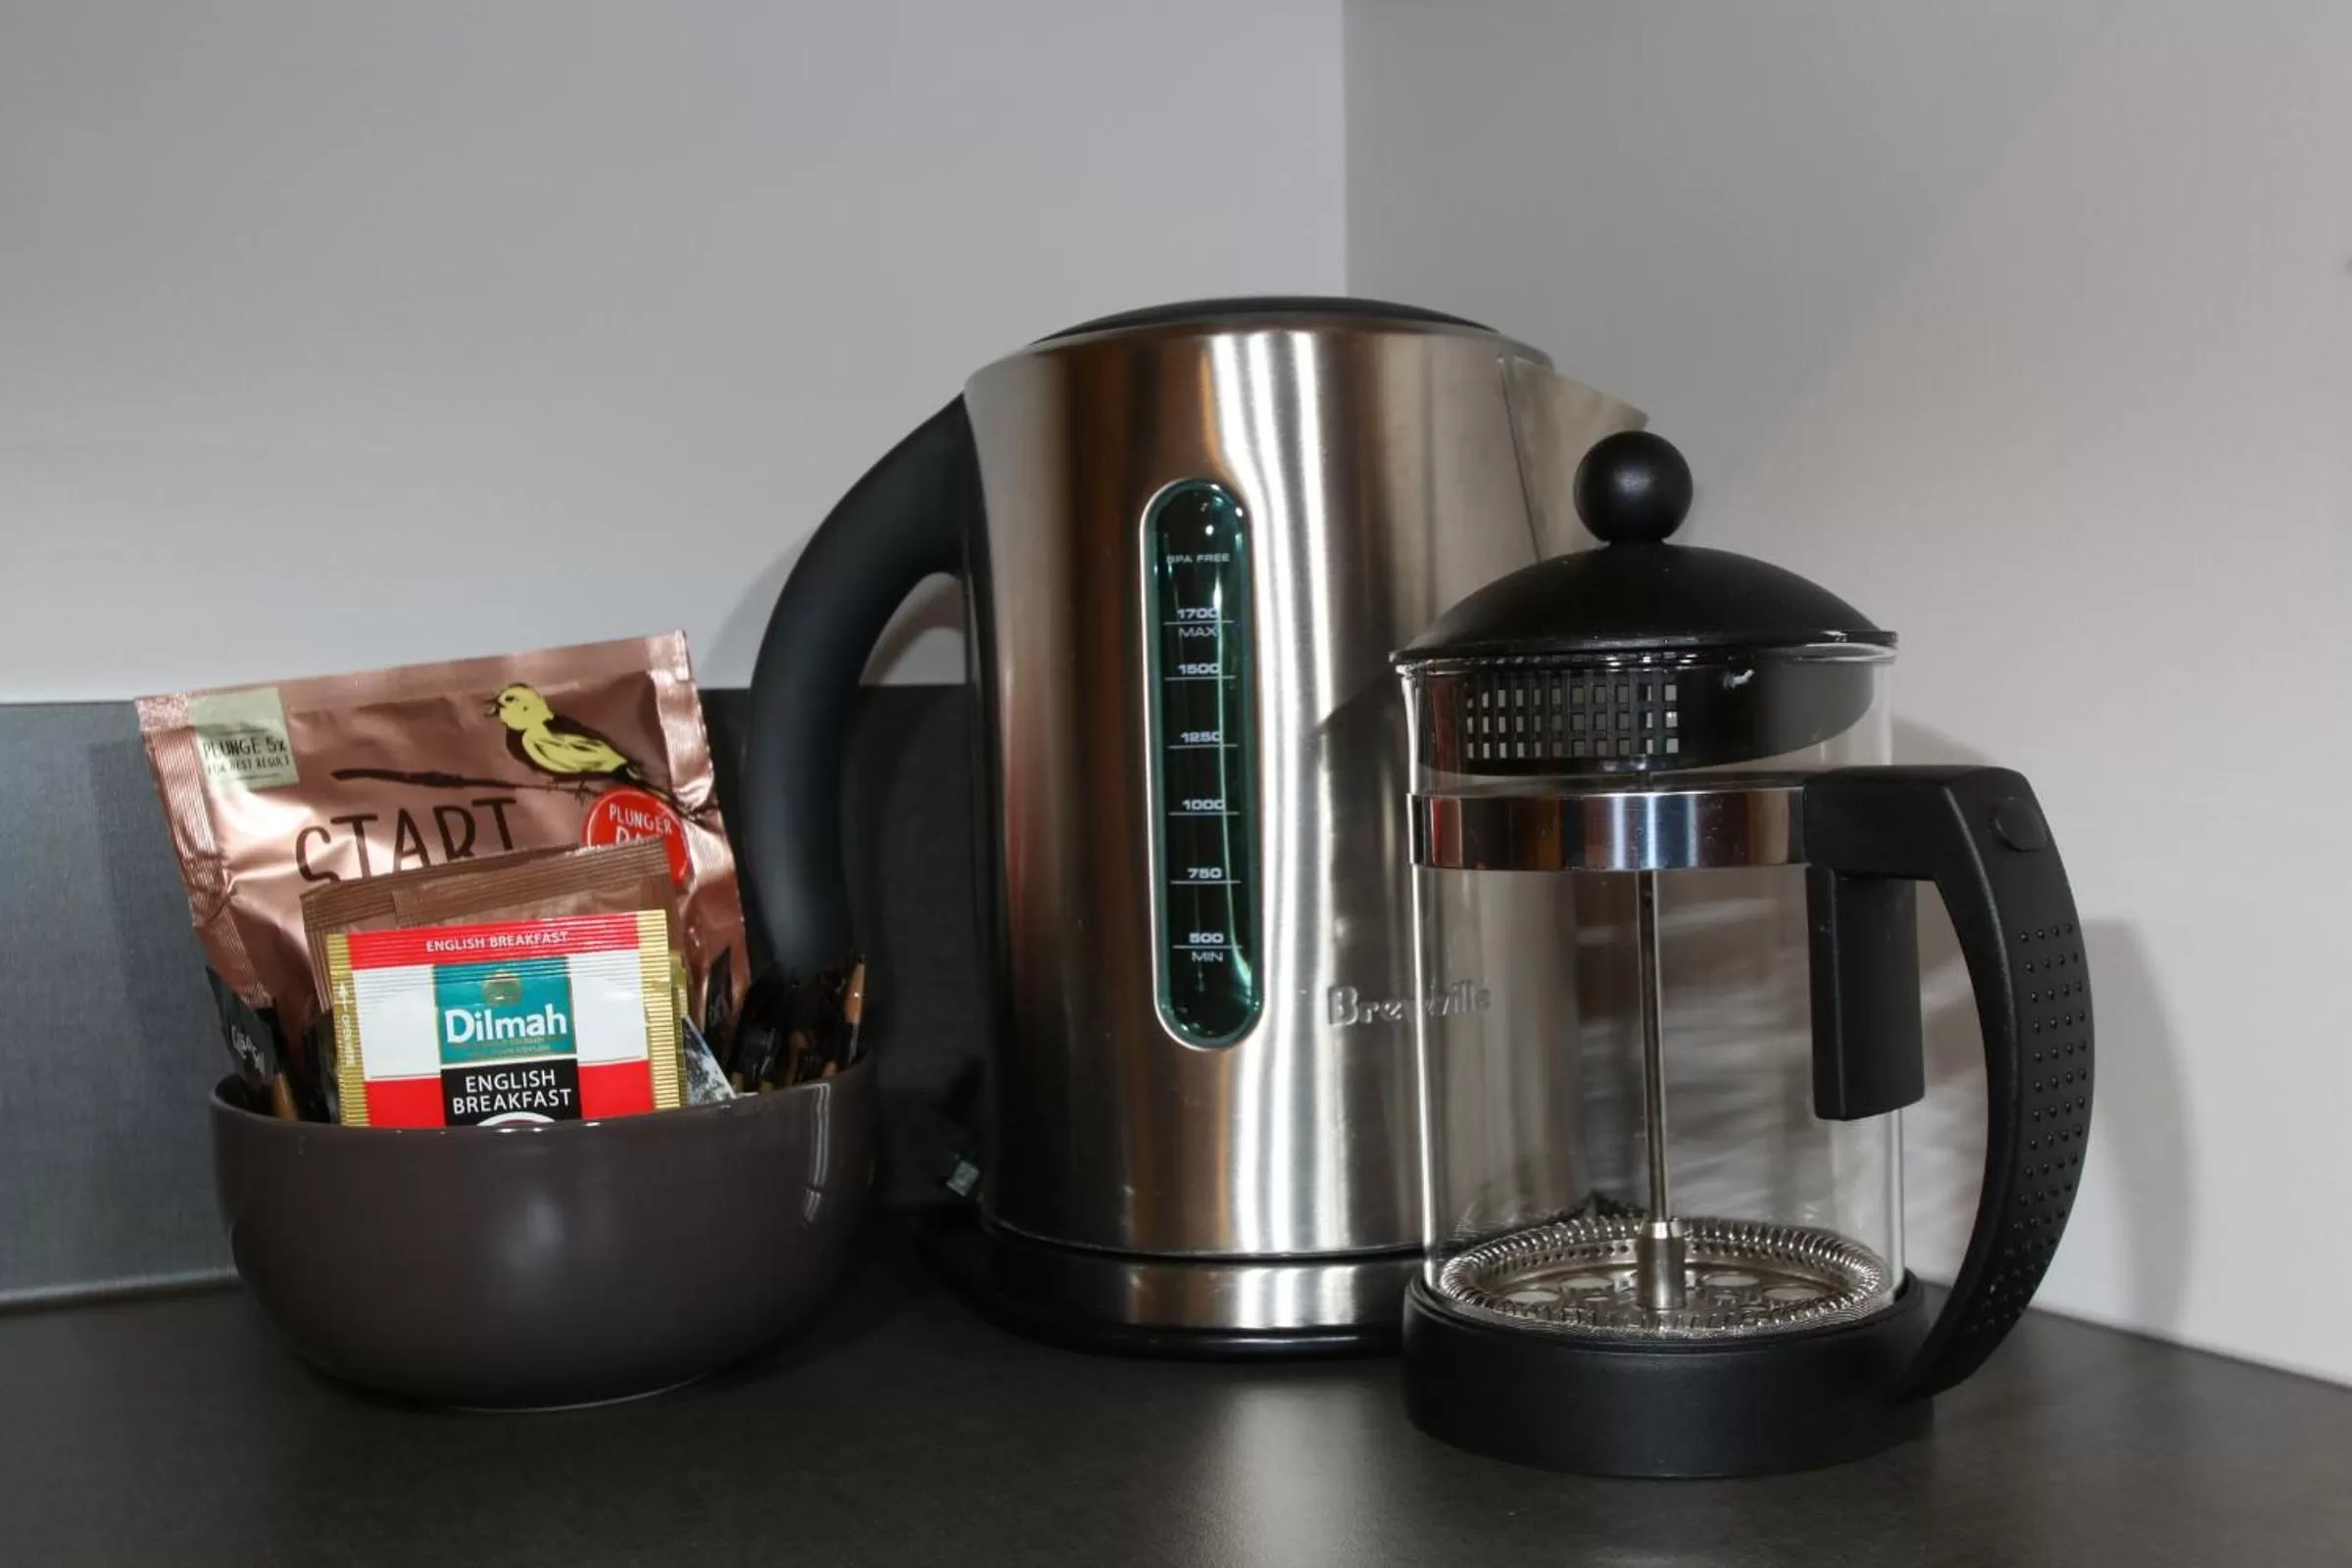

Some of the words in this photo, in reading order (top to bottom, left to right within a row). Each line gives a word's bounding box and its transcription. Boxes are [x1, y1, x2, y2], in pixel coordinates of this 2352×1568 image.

[1196, 553, 1231, 564] FREE
[1177, 607, 1219, 620] 1700
[1178, 625, 1218, 638] MAX
[1178, 663, 1221, 675] 1500
[1180, 731, 1224, 744] 1250
[1182, 799, 1225, 811] 1000
[609, 803, 673, 836] PLUNGER
[1187, 867, 1222, 879] 750
[425, 936, 487, 953] ENGLISH
[489, 931, 568, 949] BREAKFAST
[1189, 932, 1225, 945] 500
[1192, 951, 1223, 962] MIN
[445, 1004, 567, 1044] Dilmah
[465, 1068, 556, 1094] ENGLISH
[452, 1088, 572, 1114] BREAKFAST
